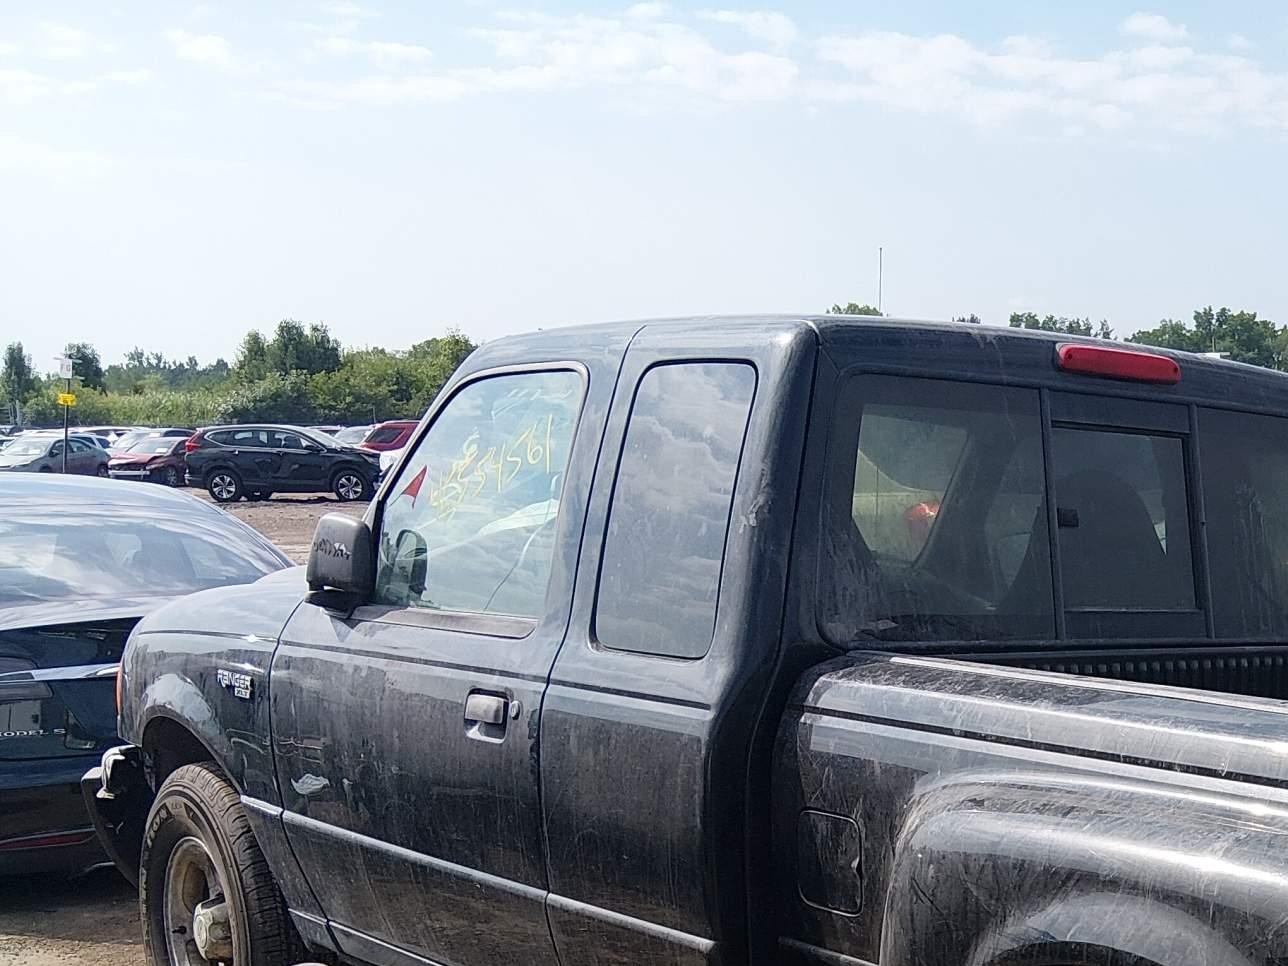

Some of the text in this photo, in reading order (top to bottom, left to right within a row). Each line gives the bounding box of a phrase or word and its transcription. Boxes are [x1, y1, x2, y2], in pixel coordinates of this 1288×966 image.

[217, 669, 252, 689] RANGER
[235, 688, 250, 698] XLT
[0, 729, 50, 737] ODEL
